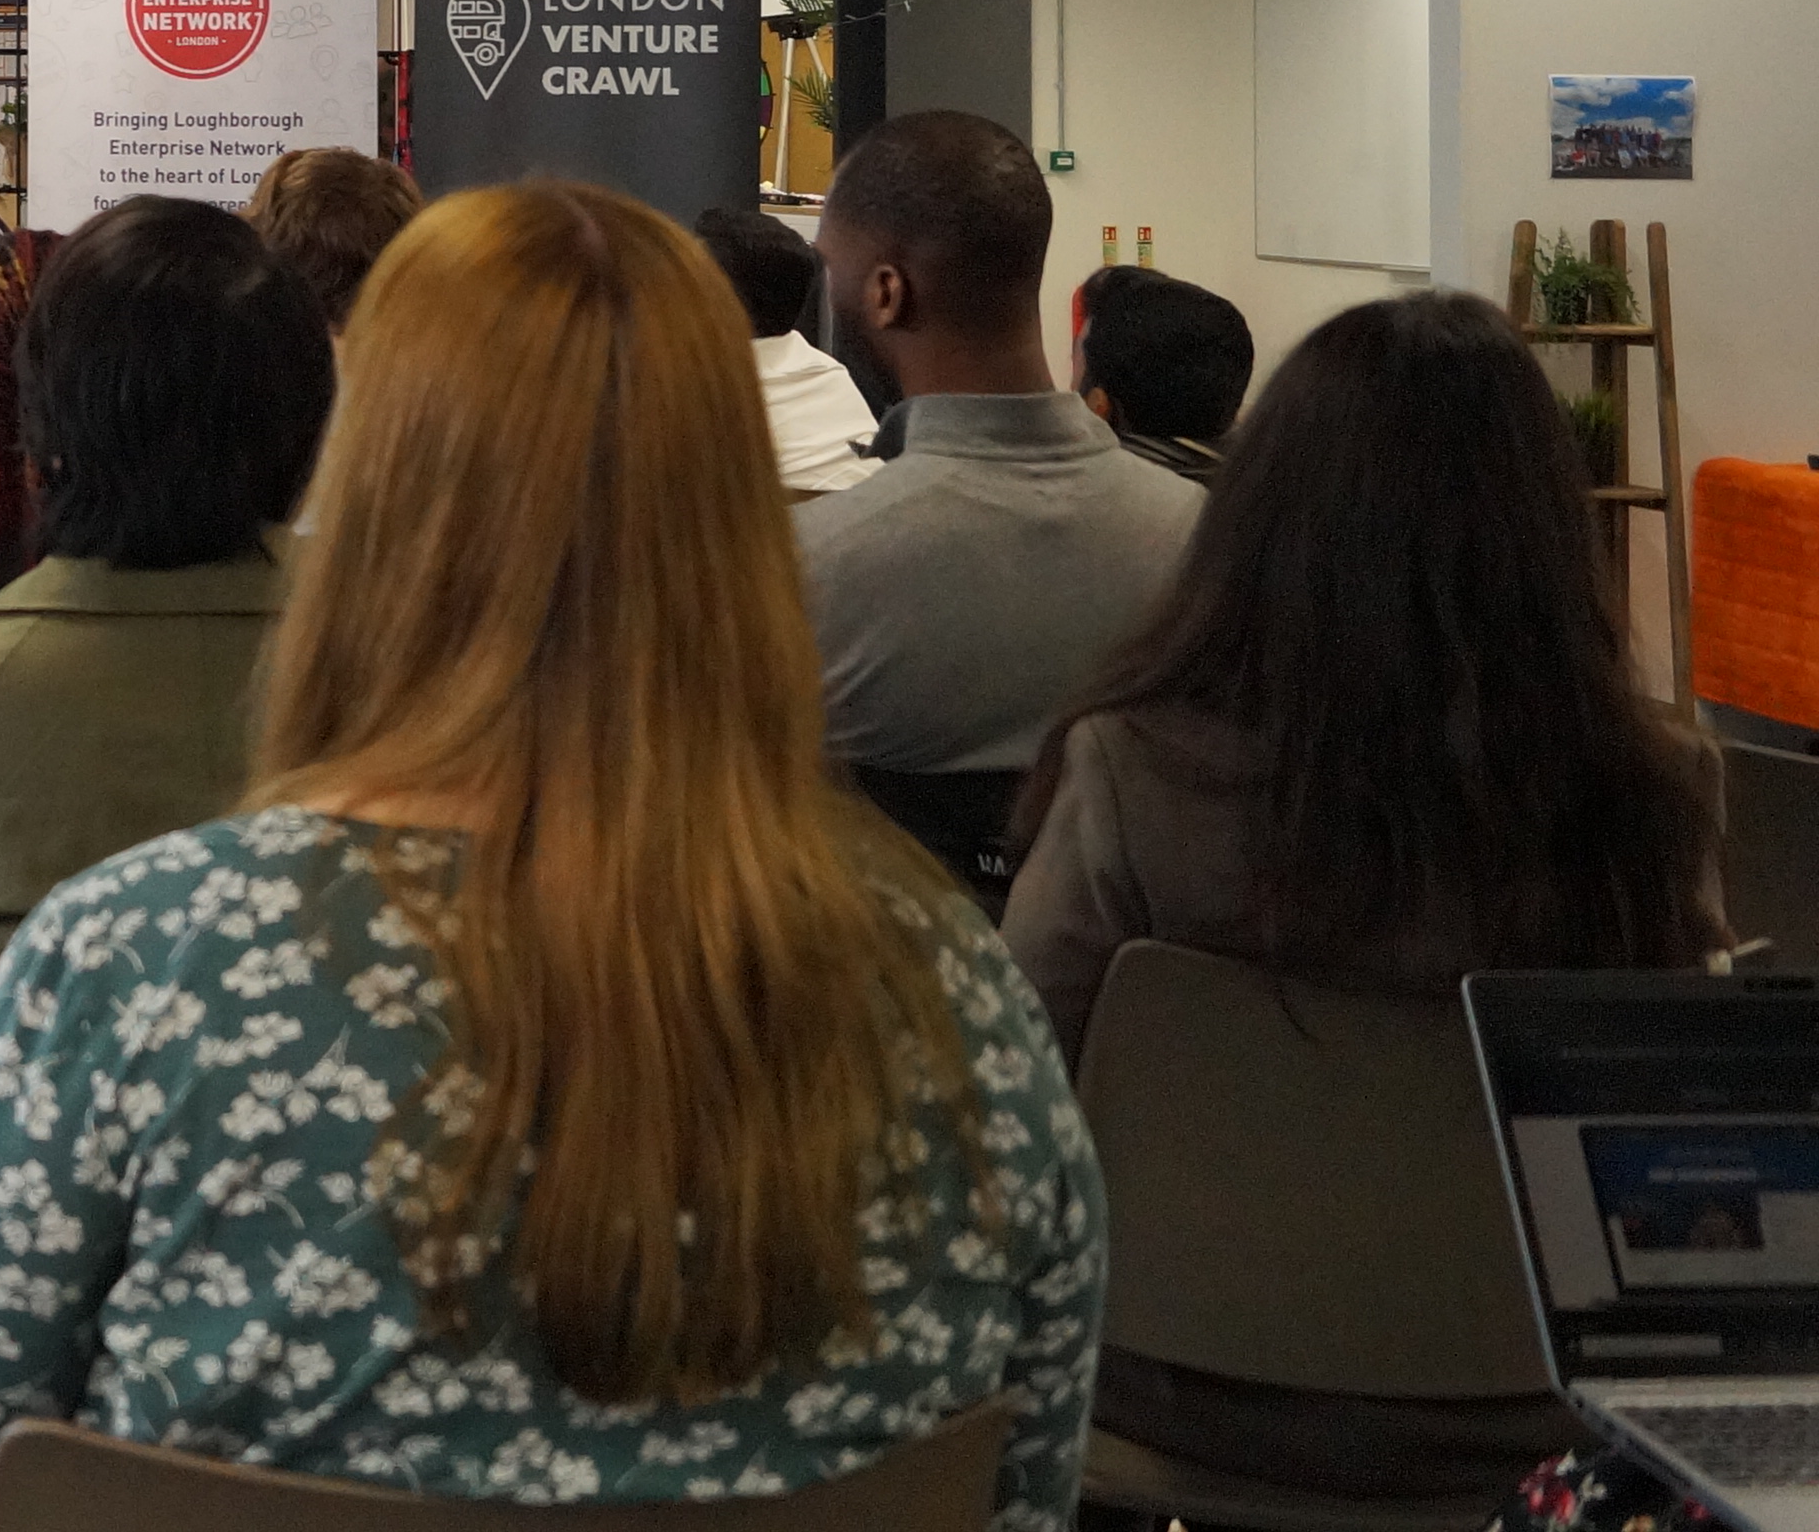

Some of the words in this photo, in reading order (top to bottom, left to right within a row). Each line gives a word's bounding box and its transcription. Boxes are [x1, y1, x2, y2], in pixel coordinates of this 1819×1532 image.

[142, 11, 252, 31] NETWORK
[176, 36, 219, 46] LONDON
[541, 24, 719, 54] VENTURE
[541, 66, 680, 96] CRAWL
[93, 111, 168, 130] Bringing
[174, 111, 304, 130] Loughborough
[109, 140, 204, 159] Enterprise
[210, 140, 285, 156] Network
[100, 170, 115, 183] to
[121, 169, 149, 183] the
[155, 168, 203, 183] heart
[208, 168, 225, 184] of
